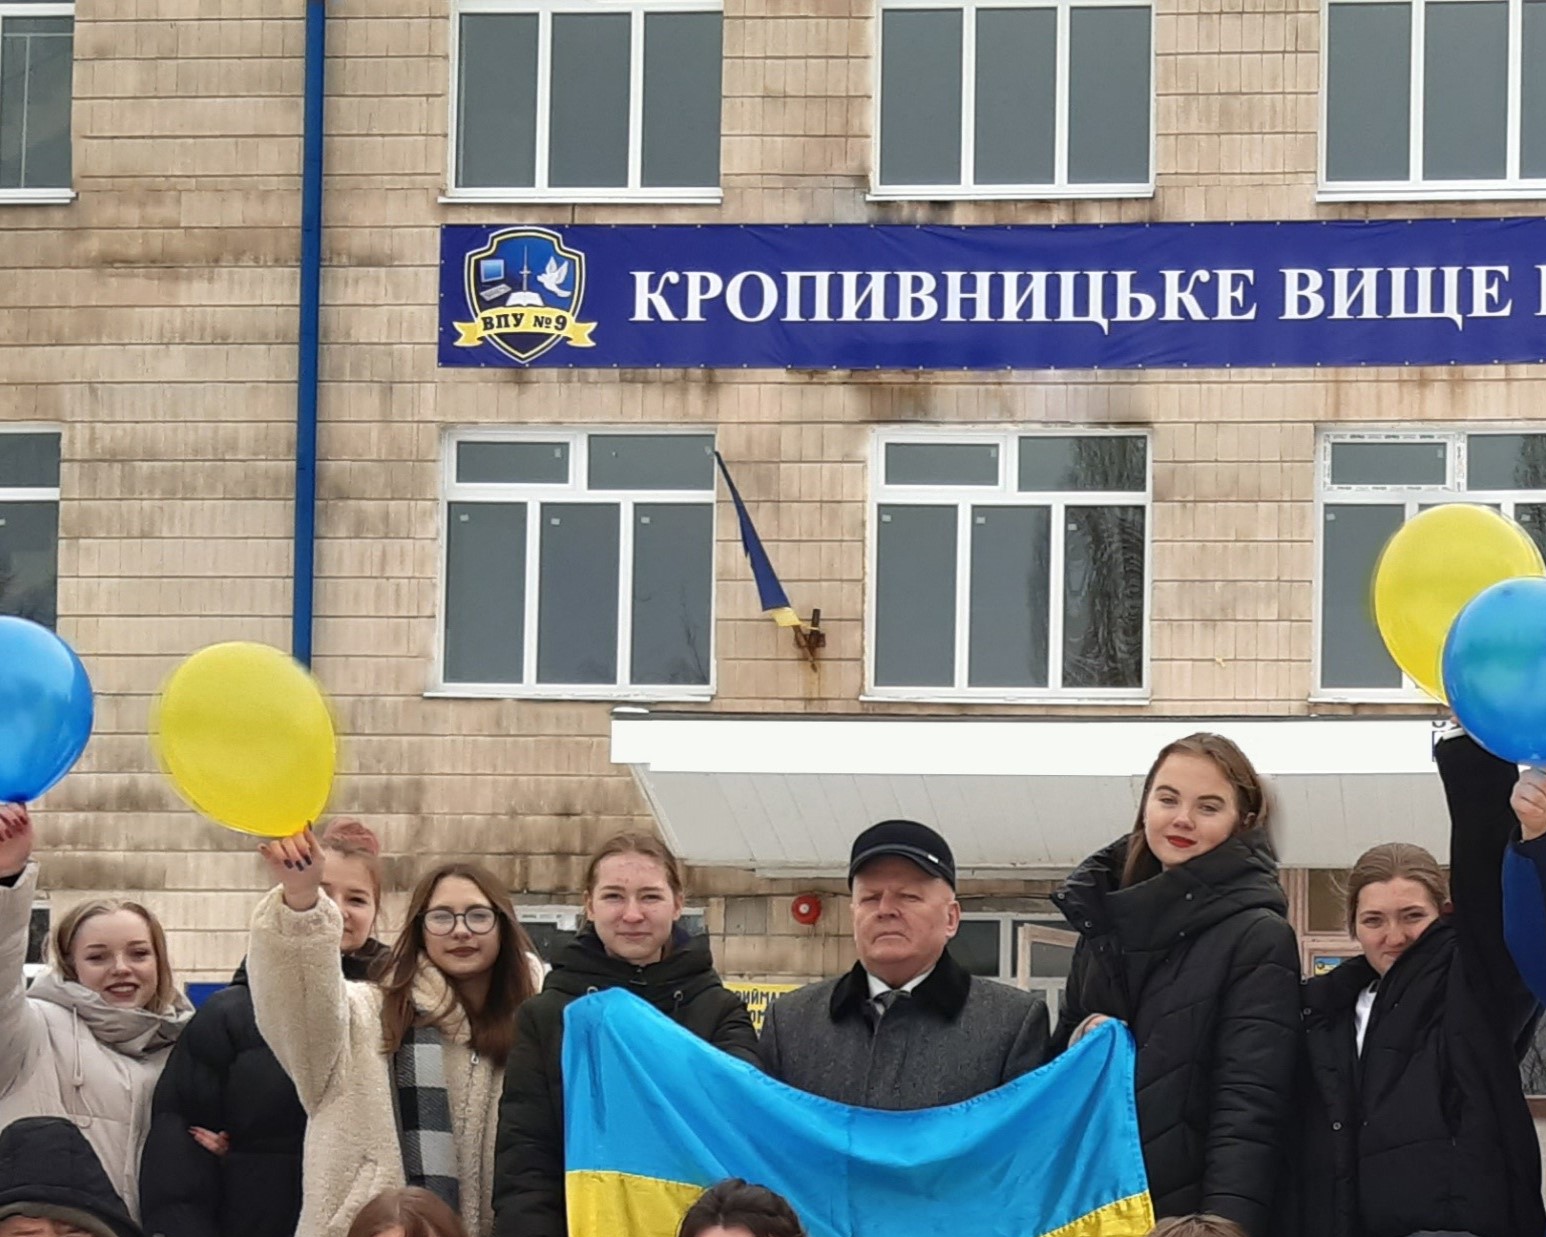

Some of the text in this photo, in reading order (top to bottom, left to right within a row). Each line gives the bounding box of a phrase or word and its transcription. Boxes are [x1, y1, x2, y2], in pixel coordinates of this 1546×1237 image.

[481, 312, 525, 331] ВПУ
[629, 269, 1257, 335] КРОПИВНИЦЬКЕ
[1279, 264, 1512, 331] ВИЩЕ
